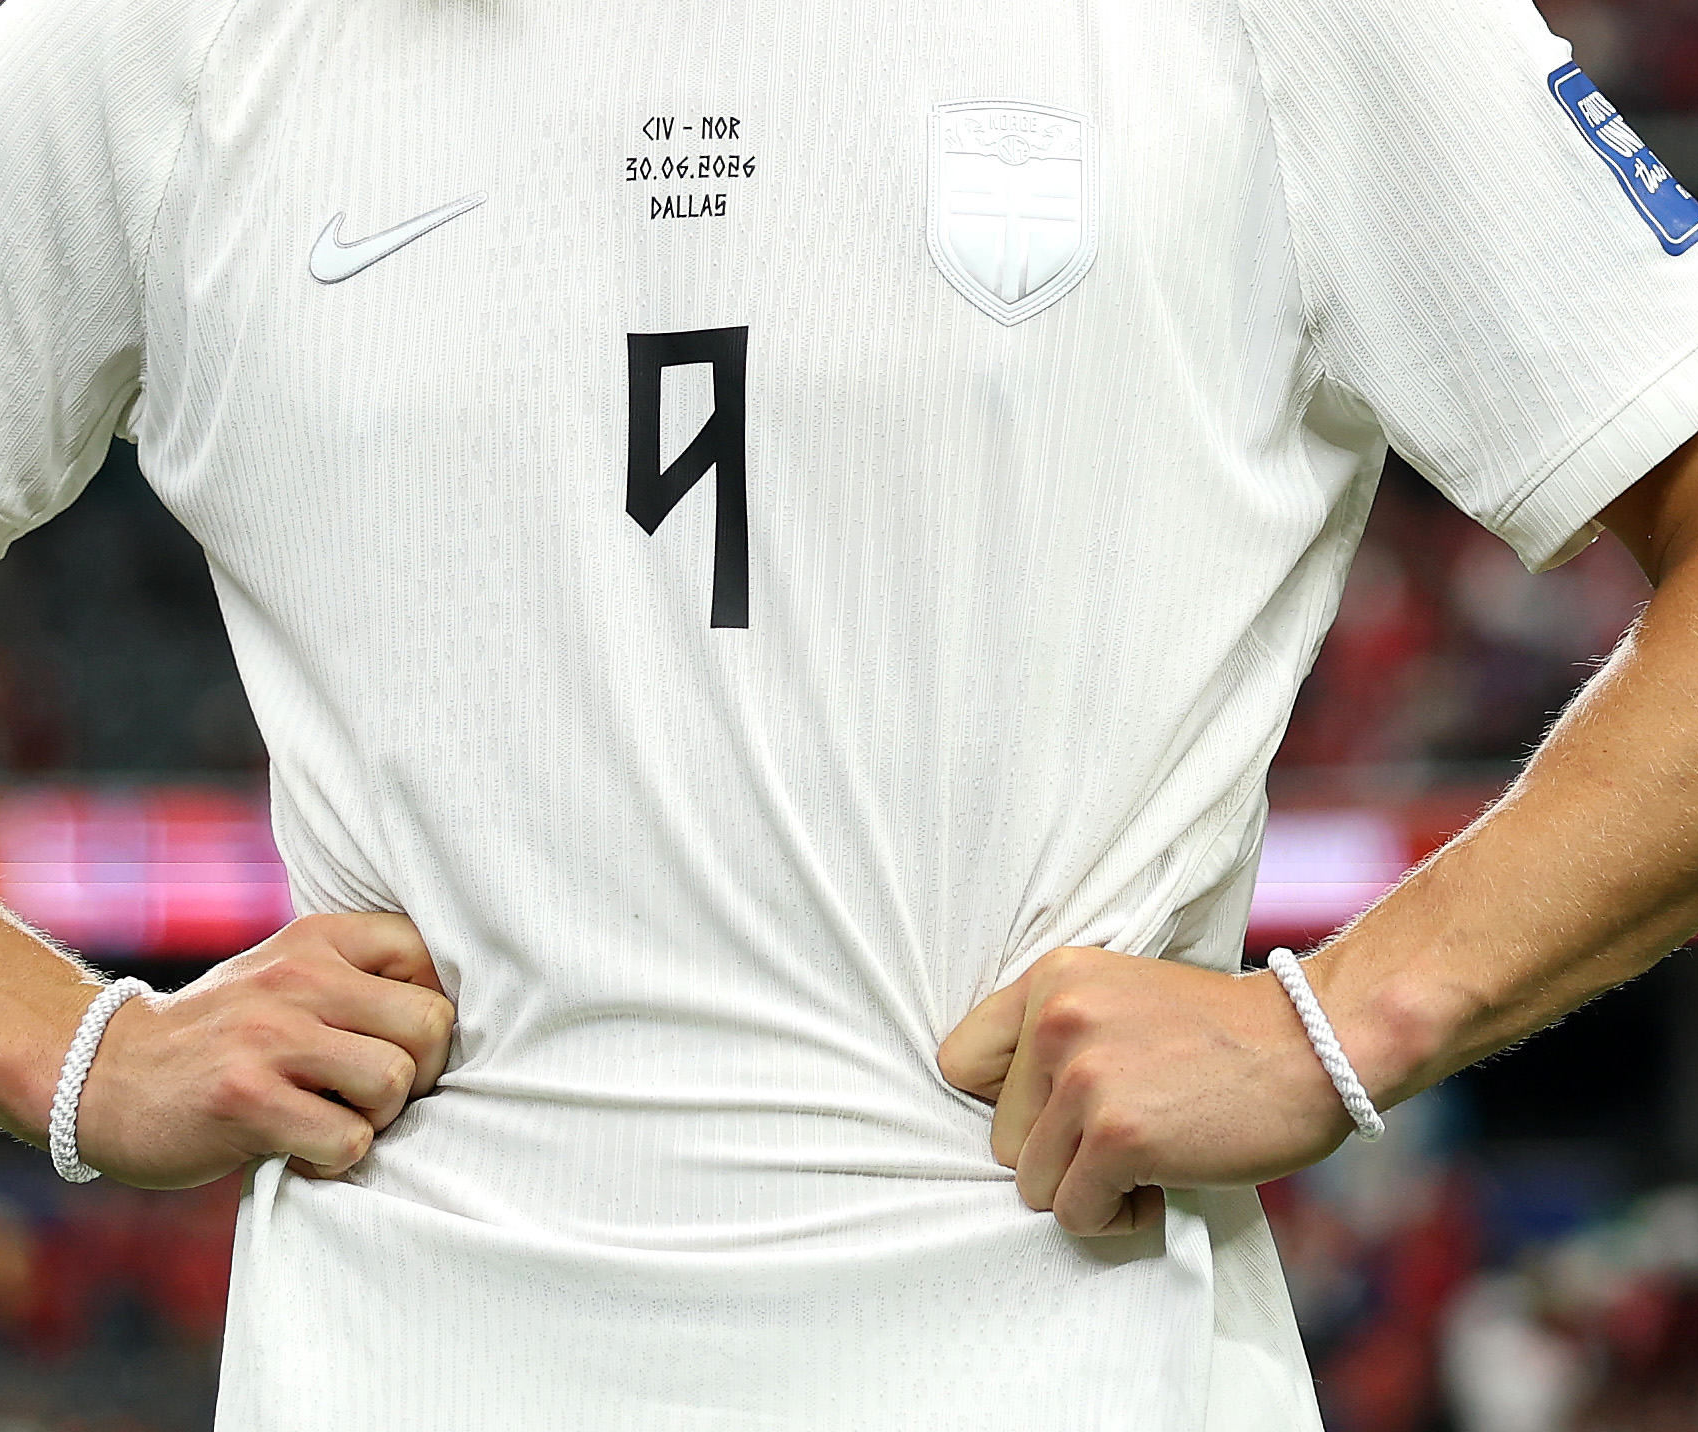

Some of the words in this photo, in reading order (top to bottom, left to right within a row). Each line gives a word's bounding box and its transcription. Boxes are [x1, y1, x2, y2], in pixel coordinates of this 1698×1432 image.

[643, 116, 675, 141] CIV
[701, 116, 741, 140] NOR
[626, 154, 756, 182] 30.06.2026
[650, 193, 727, 220] DALLAS
[625, 325, 749, 630] 9
